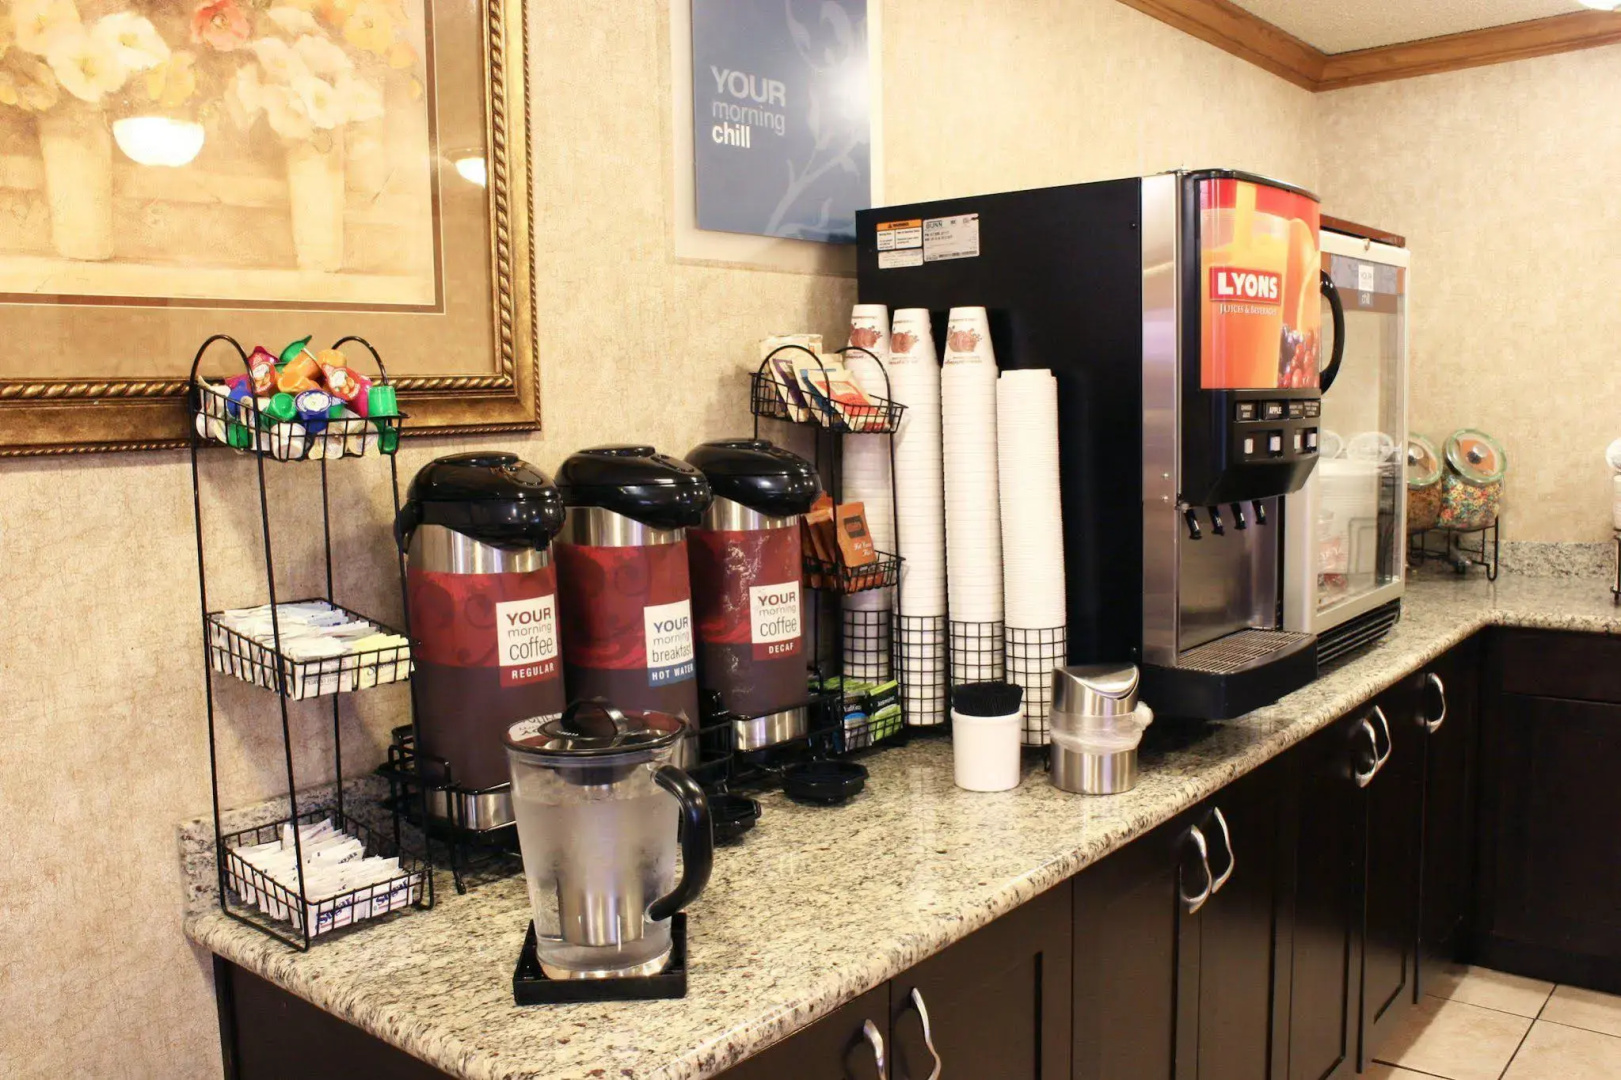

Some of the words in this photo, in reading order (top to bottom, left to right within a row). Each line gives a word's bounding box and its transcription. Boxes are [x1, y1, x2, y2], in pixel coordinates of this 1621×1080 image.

[709, 65, 786, 107] YOUR
[712, 100, 785, 136] morning
[712, 121, 750, 148] chill
[1217, 272, 1278, 299] LYONS
[1219, 303, 1243, 314] JUICES
[1269, 406, 1282, 414] APPLE
[757, 591, 796, 607] YOUR
[506, 607, 551, 626] YOUR
[760, 604, 797, 617] morning
[507, 623, 552, 638] morning
[653, 616, 689, 634] YOUR
[760, 616, 797, 637] coffee
[509, 636, 553, 661] coffee
[652, 644, 692, 663] breakfast
[768, 642, 794, 654] DECAF
[511, 662, 554, 680] REGULAR
[651, 669, 670, 681] HOT
[673, 663, 694, 677] WATER
